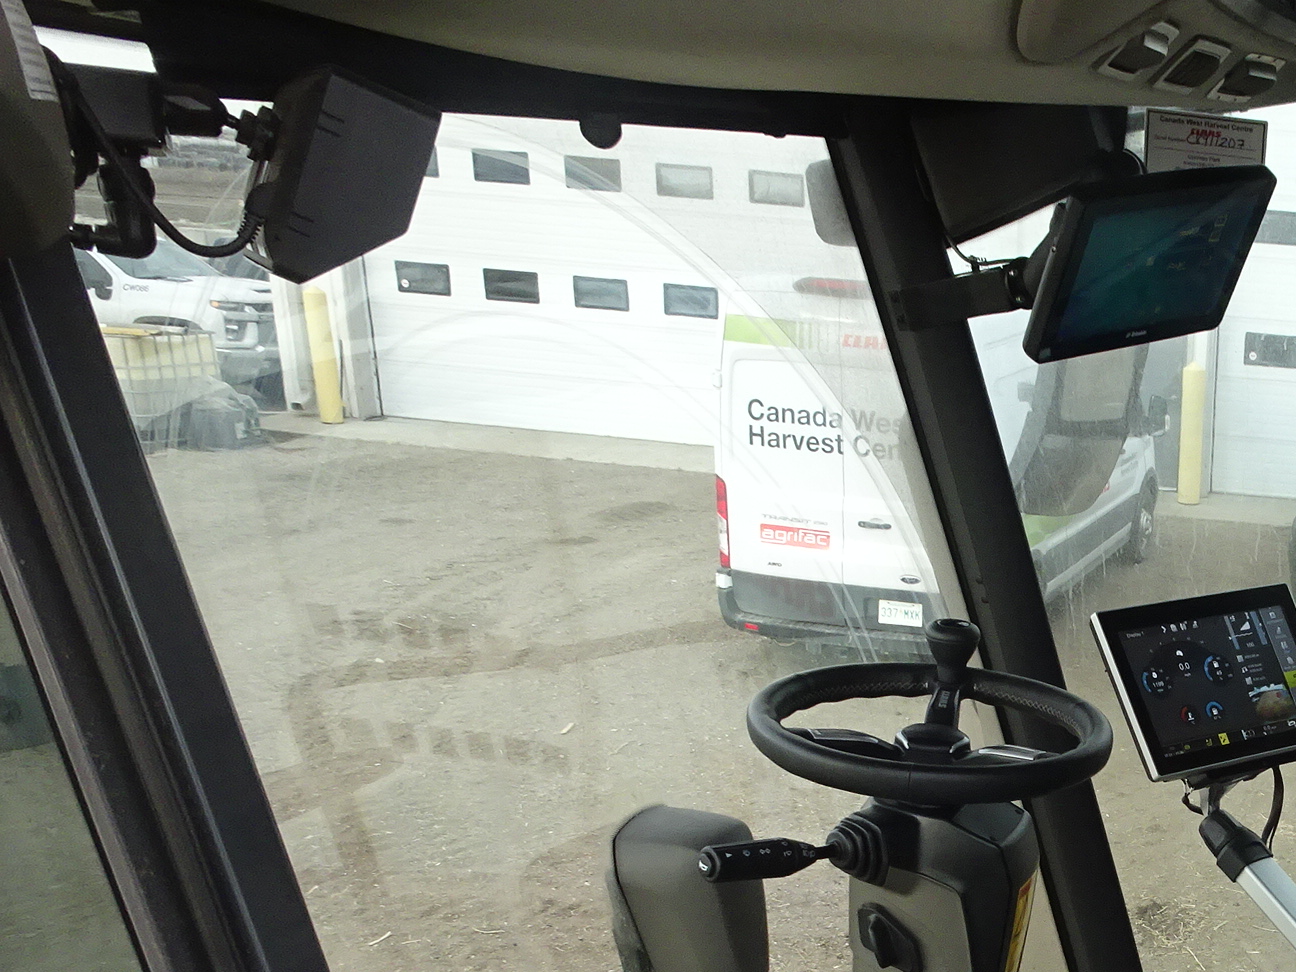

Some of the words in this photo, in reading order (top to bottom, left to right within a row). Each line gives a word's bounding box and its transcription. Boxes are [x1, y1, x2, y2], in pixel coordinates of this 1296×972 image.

[1160, 115, 1185, 125] Canada
[1186, 118, 1203, 127] West
[1204, 120, 1229, 130] Harvest
[1231, 123, 1253, 133] Centre
[747, 398, 842, 429] Canada
[850, 408, 901, 434] Wes
[749, 424, 843, 455] Harvest
[762, 528, 829, 546] agrifac
[881, 606, 899, 618] 337
[903, 609, 921, 621] MXK
[1178, 662, 1191, 671] 0.0
